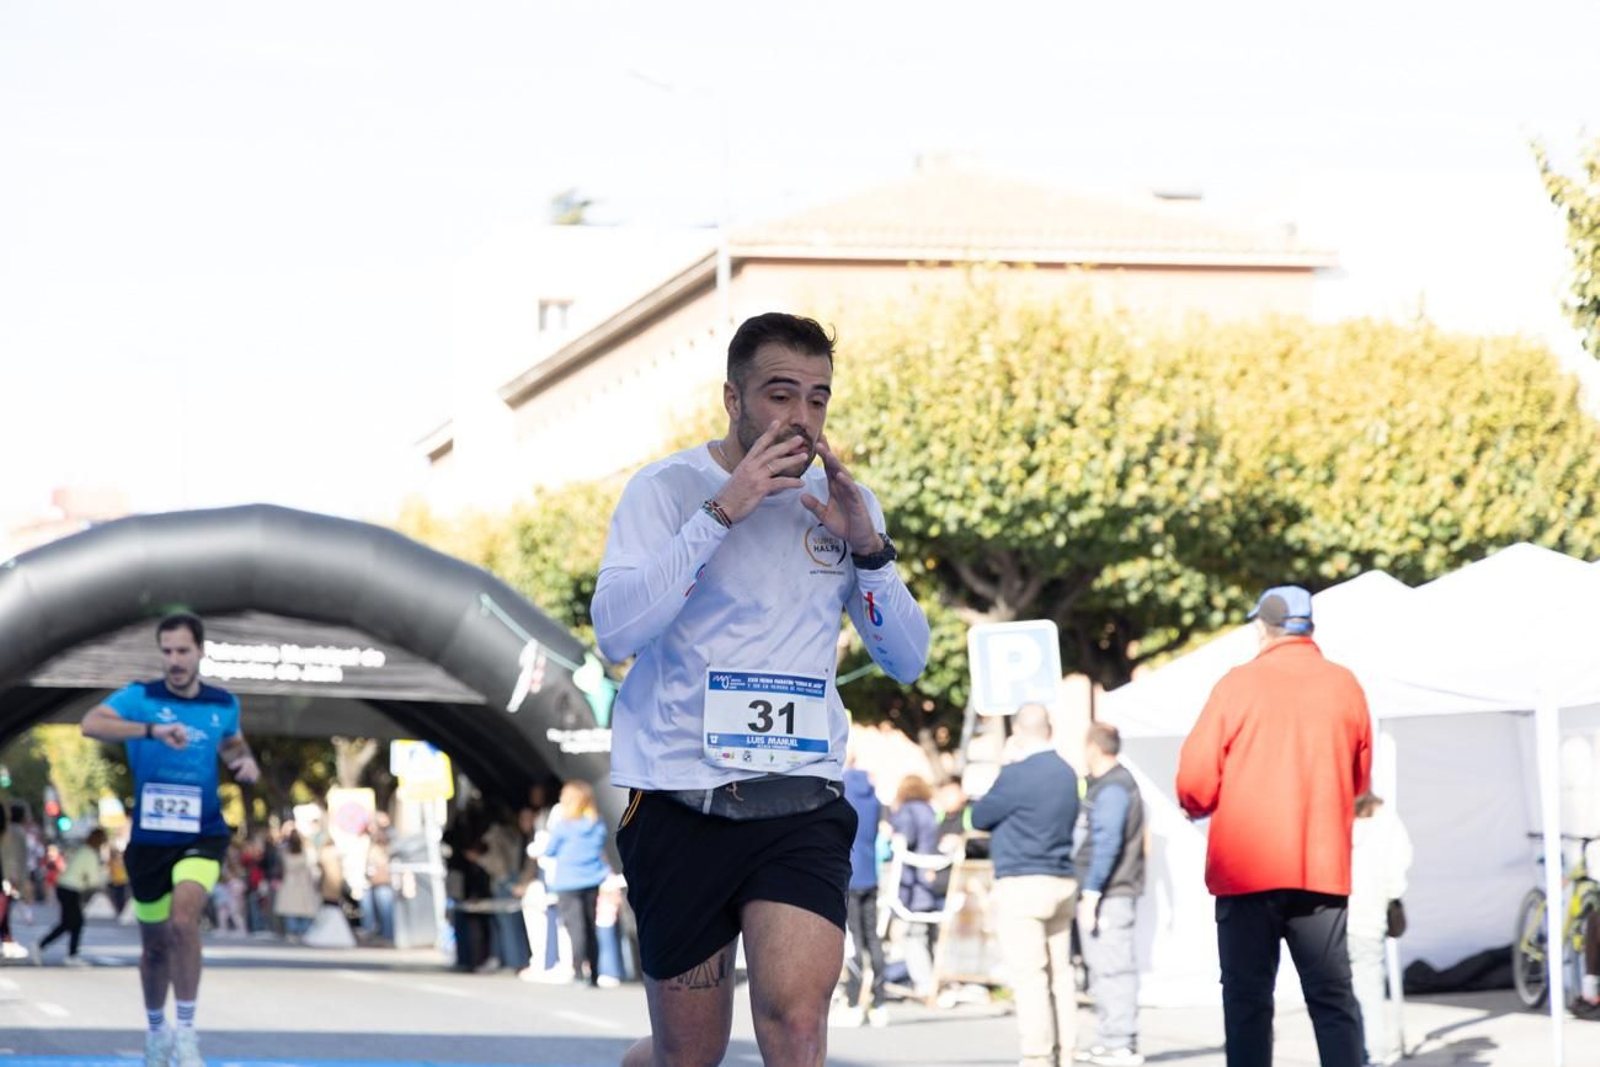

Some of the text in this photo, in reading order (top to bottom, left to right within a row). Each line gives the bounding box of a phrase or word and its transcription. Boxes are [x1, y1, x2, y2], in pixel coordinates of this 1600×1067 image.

[813, 545, 841, 553] HALFS
[987, 632, 1042, 704] P
[747, 699, 795, 735] 31
[746, 736, 765, 745] LUIS
[767, 736, 799, 747] MANUEL
[153, 798, 191, 815] 822
